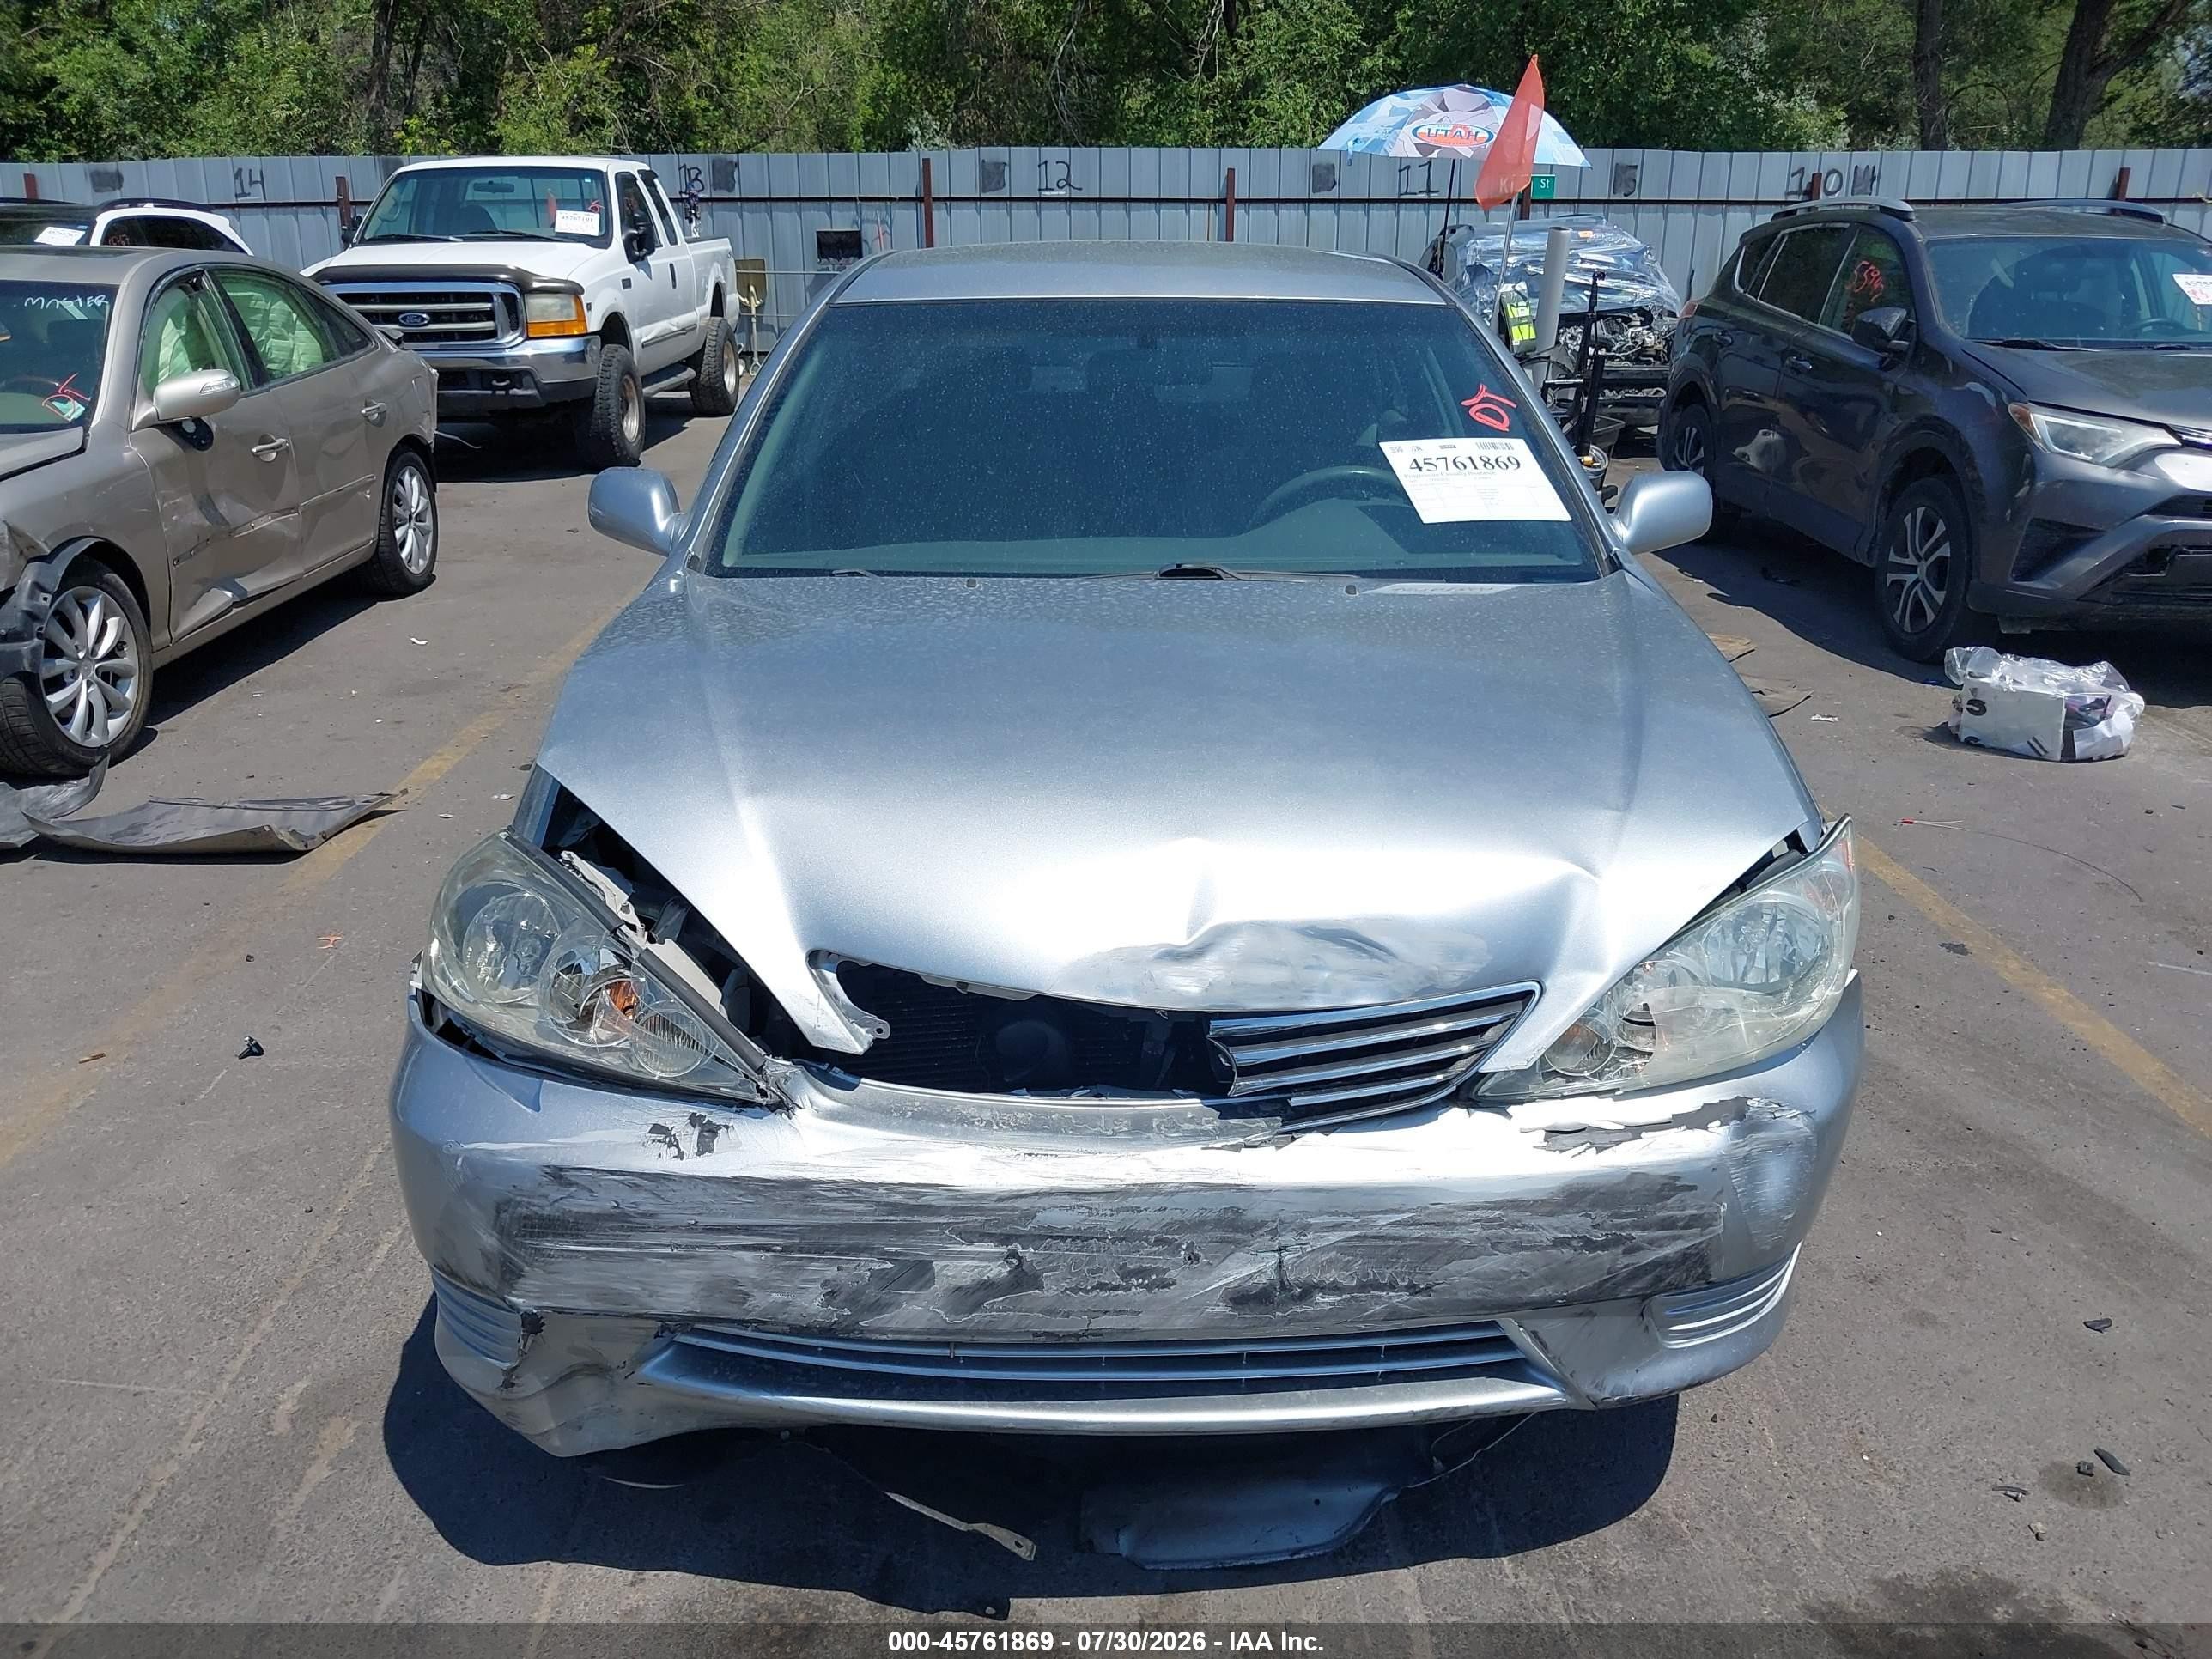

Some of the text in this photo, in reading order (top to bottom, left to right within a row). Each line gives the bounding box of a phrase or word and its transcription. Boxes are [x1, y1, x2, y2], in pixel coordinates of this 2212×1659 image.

[1427, 128, 1482, 142] UTAH
[234, 167, 267, 201] 14
[1038, 160, 1083, 191] 12
[1399, 161, 1440, 197] 11
[1540, 178, 1550, 189] St
[24, 295, 110, 310] MASTER
[1409, 455, 1521, 472] 45761869
